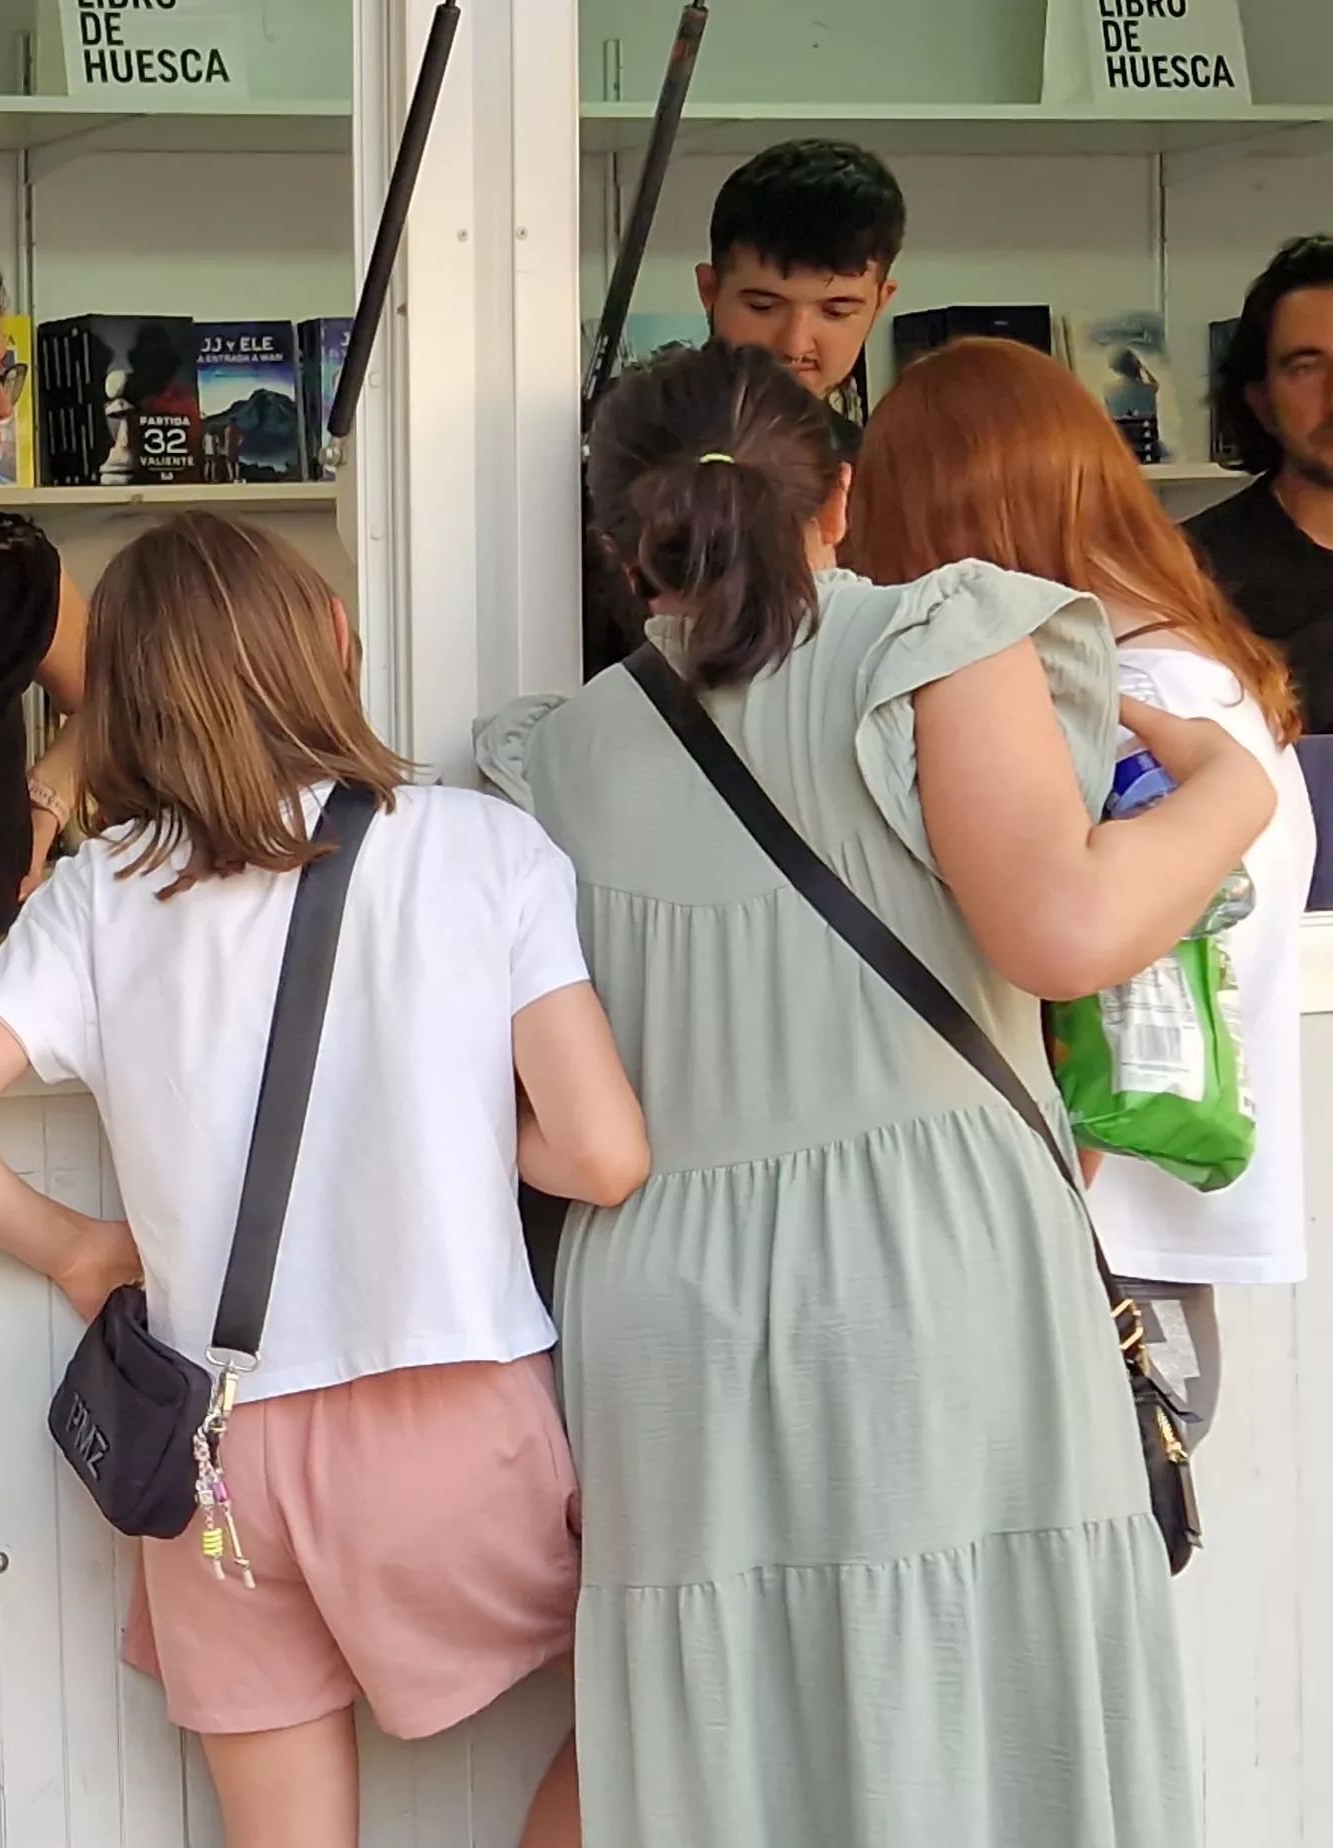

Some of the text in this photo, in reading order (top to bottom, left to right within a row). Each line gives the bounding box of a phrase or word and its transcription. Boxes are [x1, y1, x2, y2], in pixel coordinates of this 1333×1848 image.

[80, 11, 124, 46] DE
[1102, 20, 1142, 52] DE
[84, 48, 231, 83] HUESCA
[1106, 55, 1235, 88] HUESCA
[240, 336, 274, 351] ELE
[139, 415, 191, 427] PARTIDA
[143, 428, 189, 454] 32
[139, 455, 195, 467] VALIENTE
